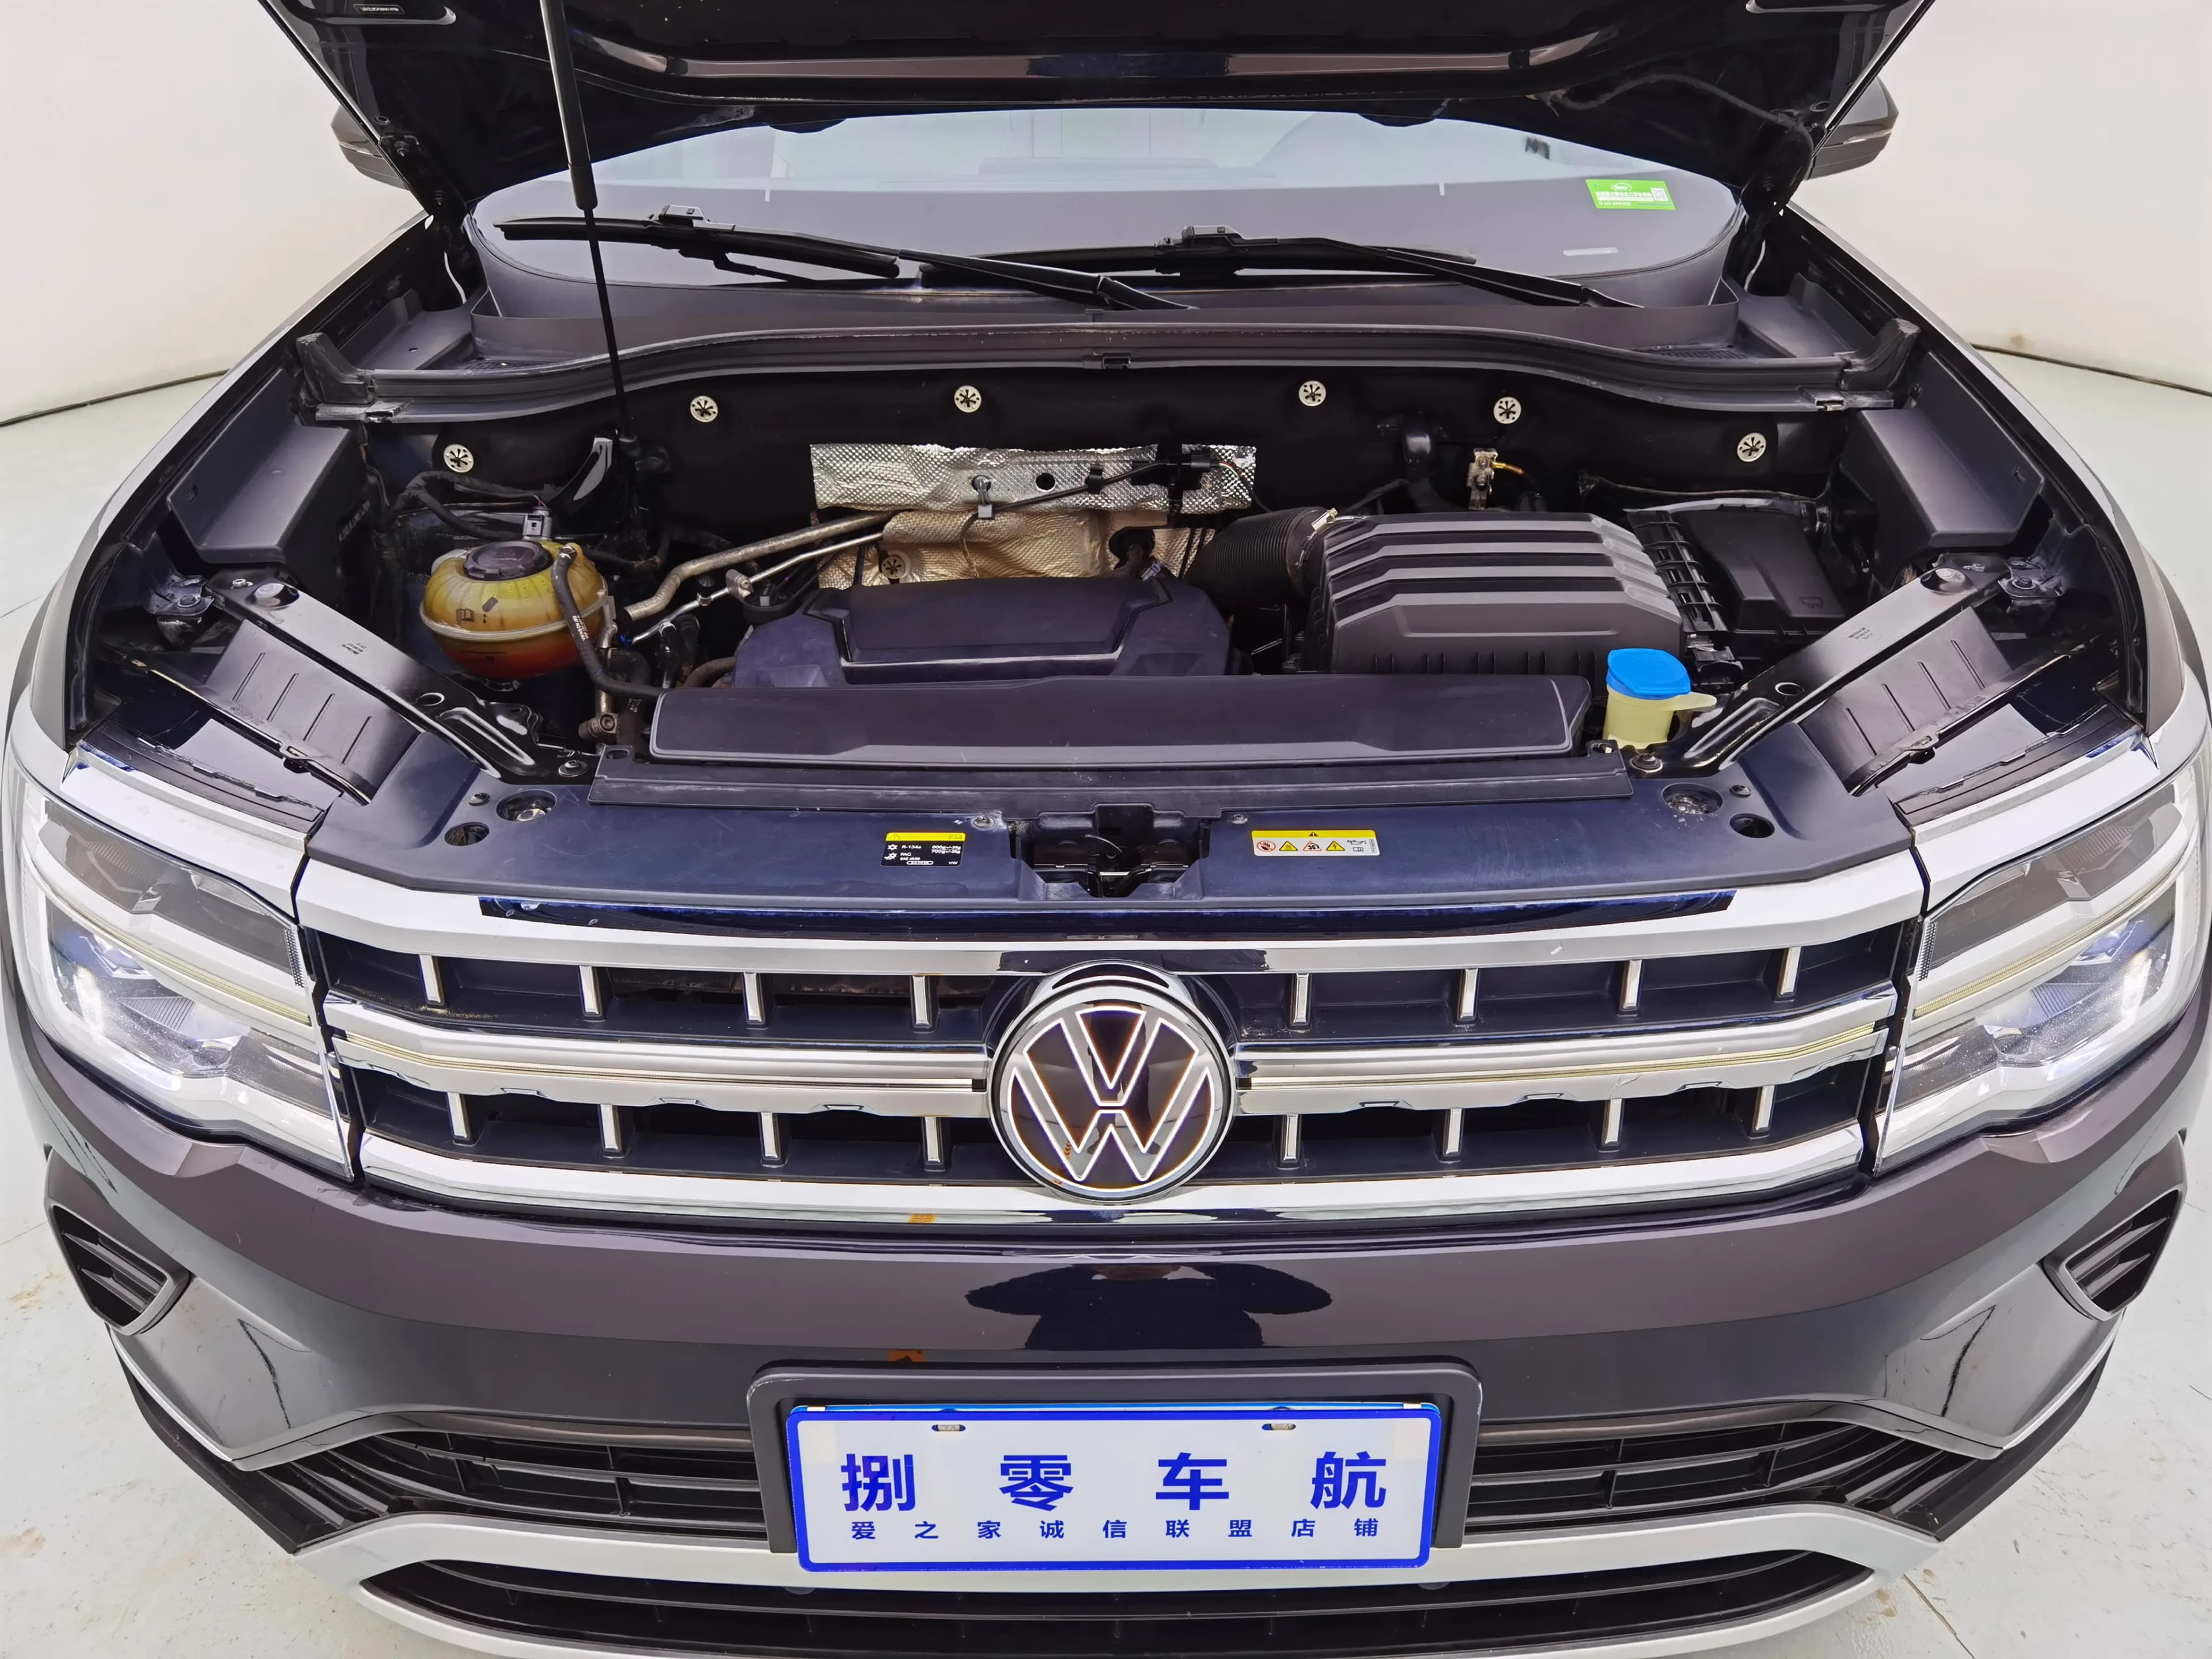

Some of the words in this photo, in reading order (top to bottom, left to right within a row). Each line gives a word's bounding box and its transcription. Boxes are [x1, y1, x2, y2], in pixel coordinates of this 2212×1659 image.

[840, 1451, 1387, 1512] 捌零车航
[851, 1518, 1379, 1540] 爱之家诚信联盟店铺
